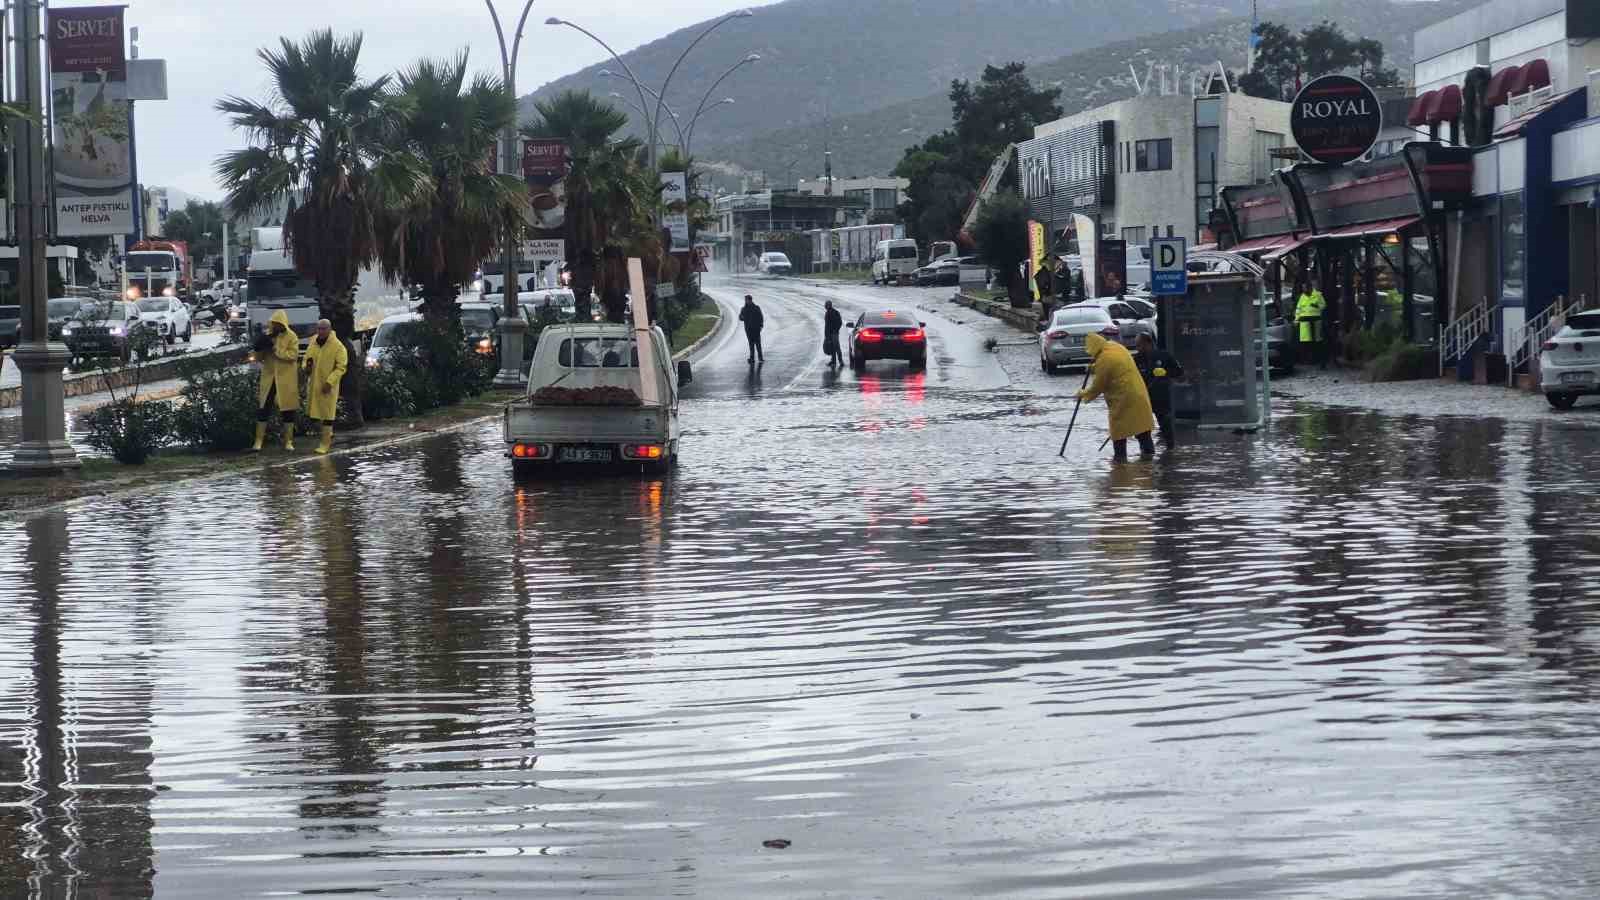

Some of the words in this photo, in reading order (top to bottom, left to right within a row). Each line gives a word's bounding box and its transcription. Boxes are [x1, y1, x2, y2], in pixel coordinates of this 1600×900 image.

[57, 17, 118, 39] SERVET
[1302, 99, 1371, 118] ROYAL
[61, 203, 91, 213] ANTEP
[81, 214, 111, 223] HELVA
[1160, 244, 1176, 268] D
